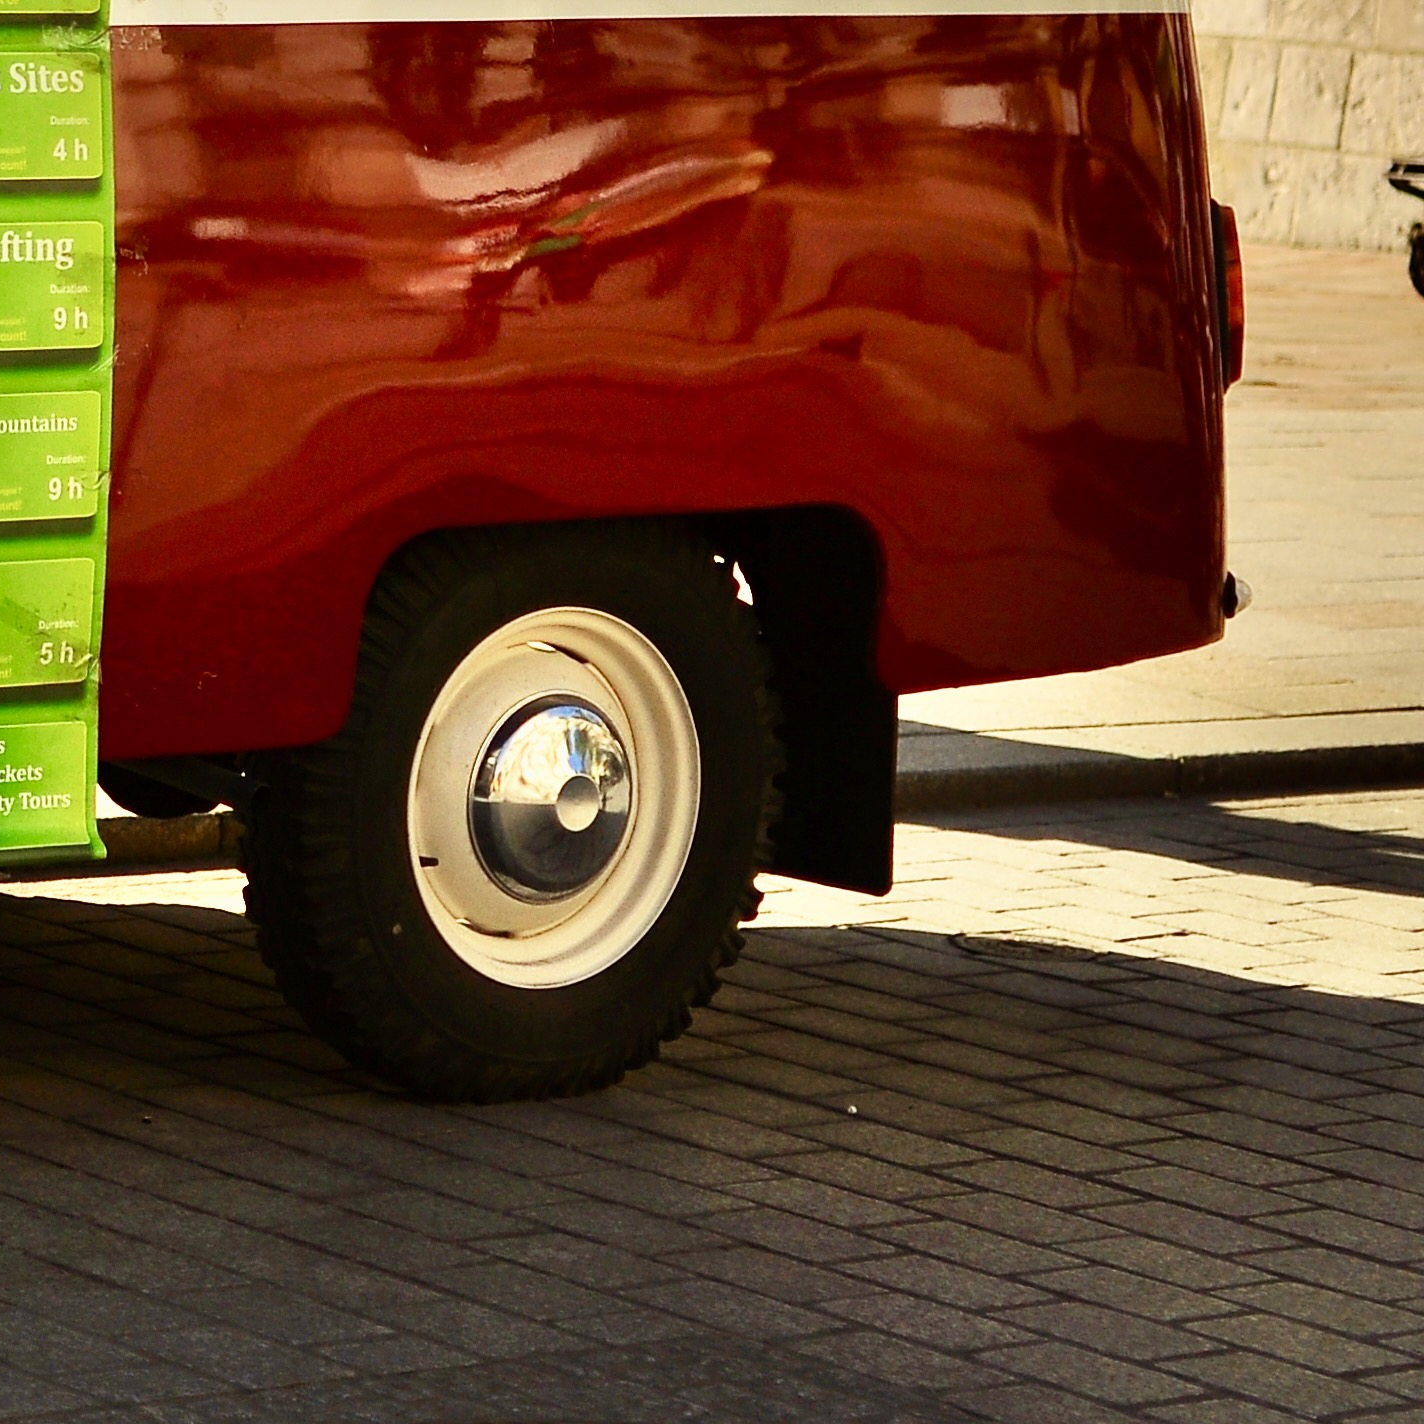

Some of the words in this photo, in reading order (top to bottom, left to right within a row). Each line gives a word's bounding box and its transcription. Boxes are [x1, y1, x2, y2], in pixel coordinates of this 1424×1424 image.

[10, 63, 84, 93] Sites
[50, 116, 89, 125] Duration:
[54, 138, 67, 160] 4
[74, 138, 87, 160] h
[50, 284, 90, 294] Duration:
[54, 307, 66, 330] 9
[75, 306, 87, 329] h
[47, 455, 85, 464] Duration:
[49, 478, 61, 500] 9
[69, 477, 82, 499] h
[40, 643, 53, 665] 5
[60, 641, 73, 663] h
[19, 792, 71, 810] Tours
